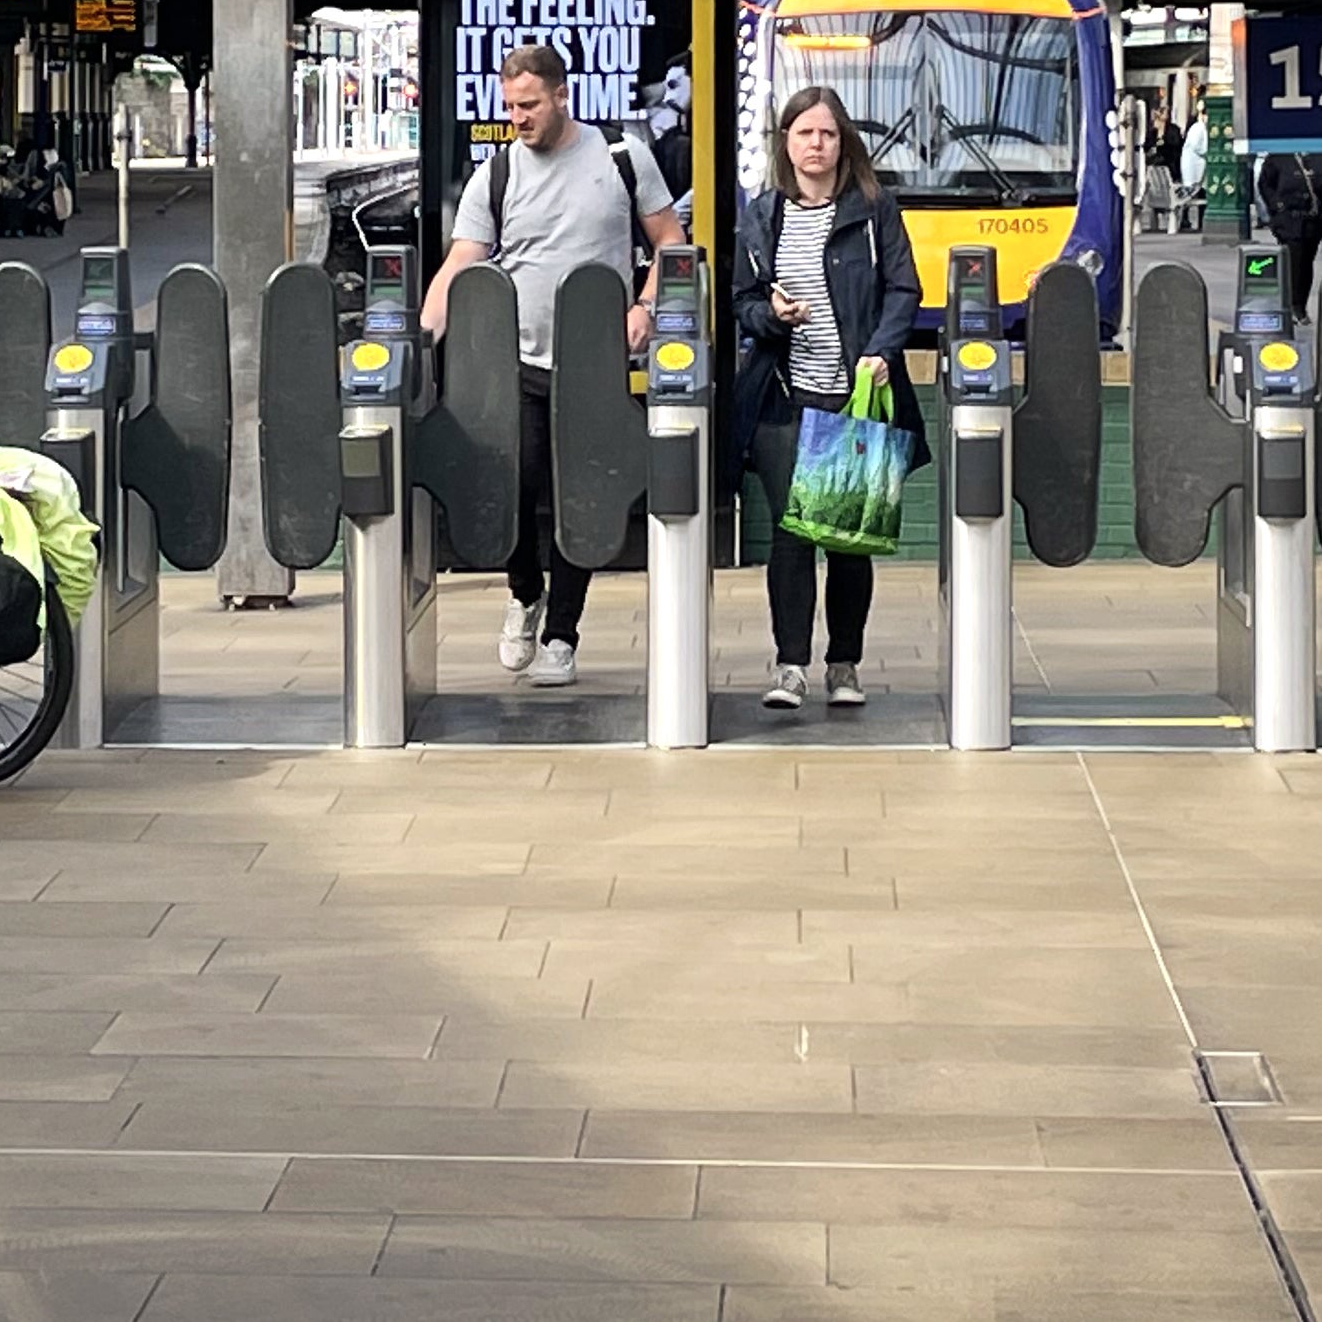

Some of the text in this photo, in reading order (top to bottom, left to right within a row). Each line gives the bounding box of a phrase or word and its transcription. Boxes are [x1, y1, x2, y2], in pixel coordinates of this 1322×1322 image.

[456, 26, 487, 73] IT
[577, 26, 641, 73] YOU
[567, 73, 649, 121] TIME.
[978, 217, 1049, 235] 170405
